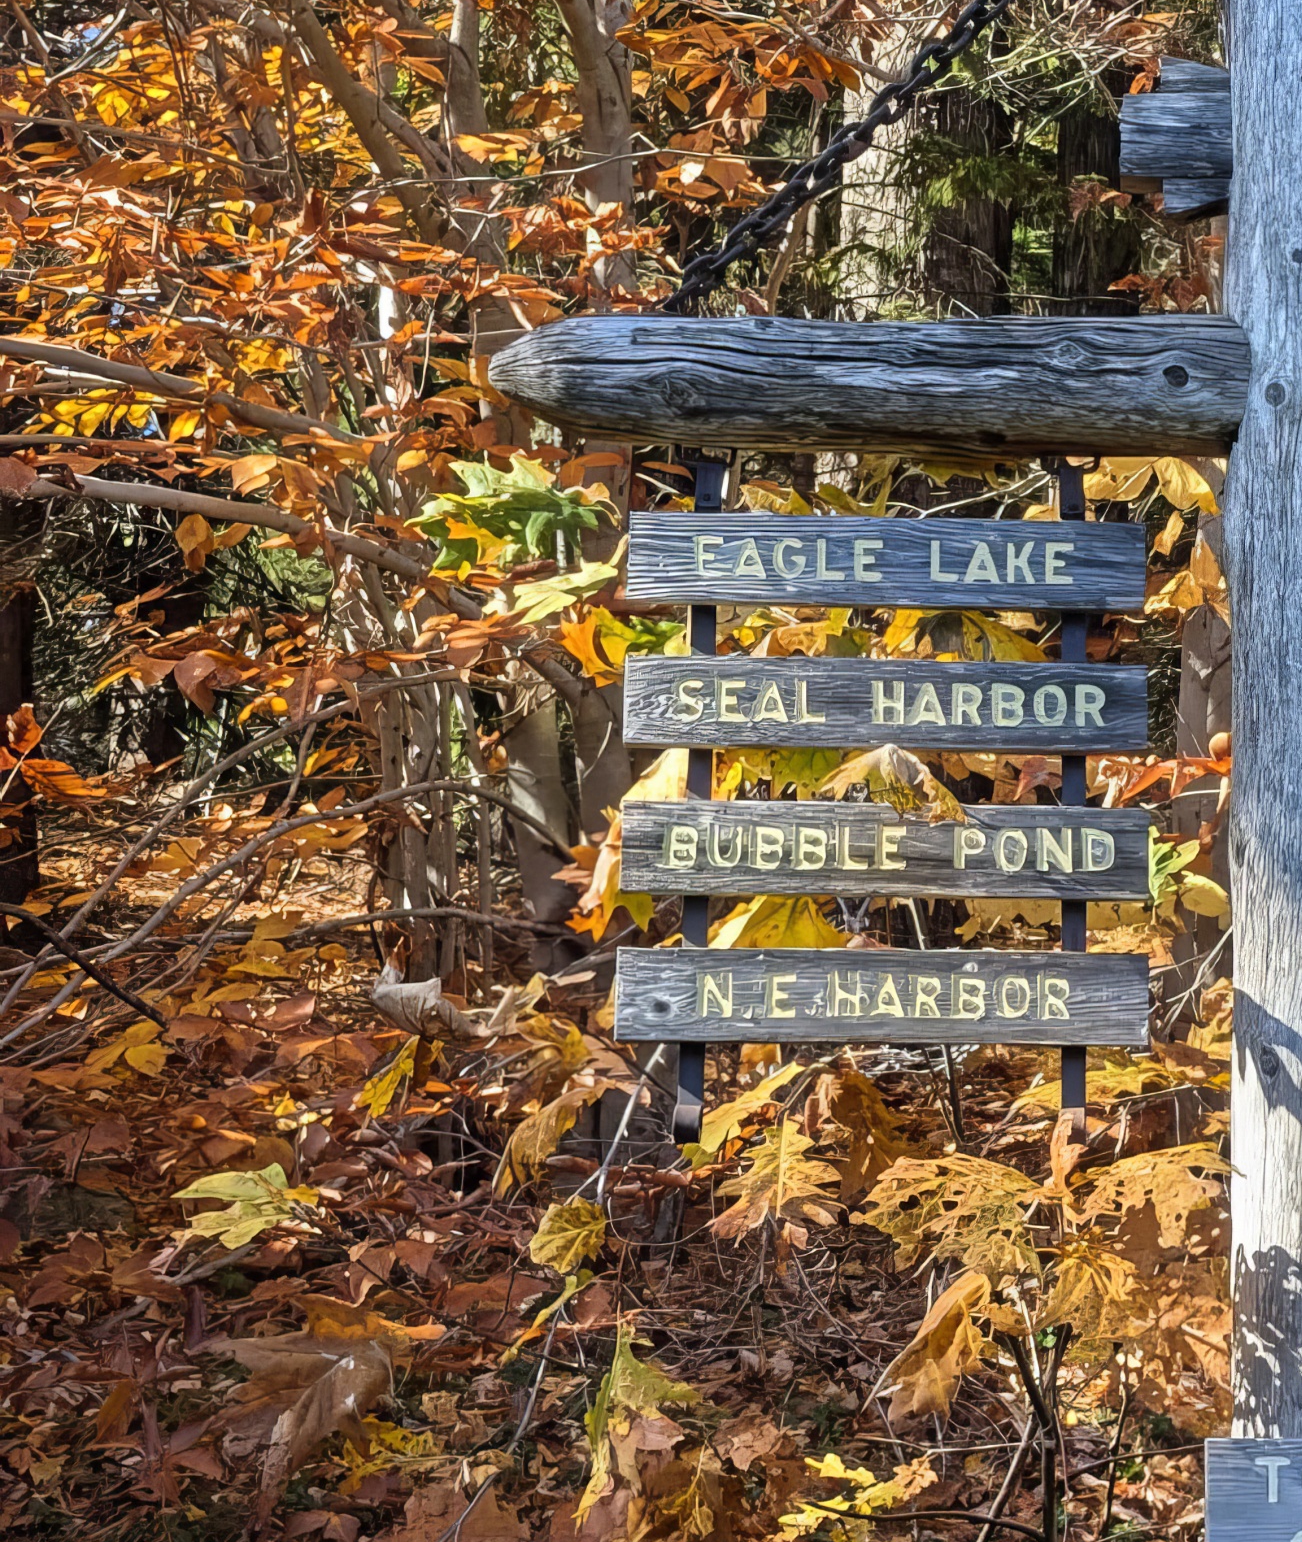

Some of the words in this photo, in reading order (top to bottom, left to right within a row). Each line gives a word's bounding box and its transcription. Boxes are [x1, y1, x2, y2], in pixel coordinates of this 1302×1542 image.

[693, 535, 884, 583] EAGLE
[929, 540, 1075, 585] LAKE
[676, 680, 827, 724] SEAL
[871, 680, 1107, 728] HARBOR
[663, 824, 907, 872] BUBBLE
[953, 826, 1117, 873] POND
[827, 971, 1071, 1021] HARBOR
